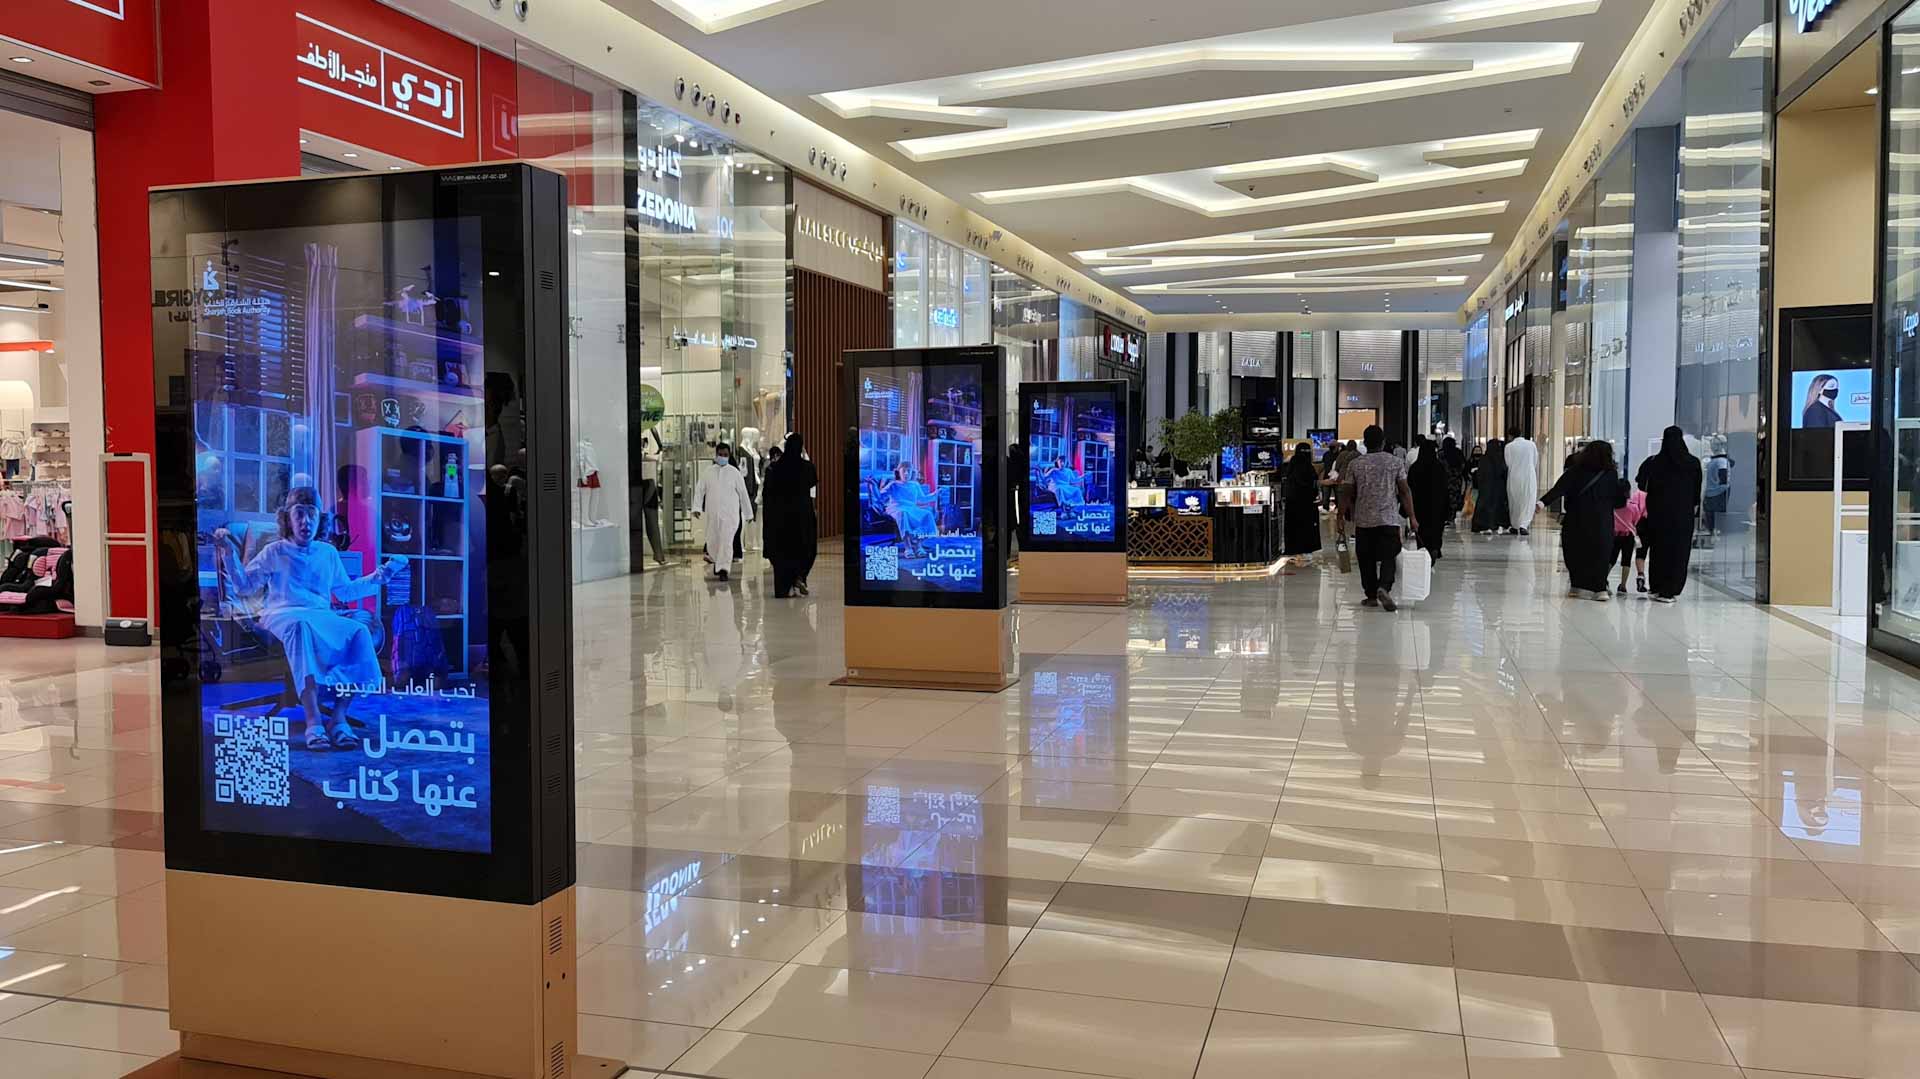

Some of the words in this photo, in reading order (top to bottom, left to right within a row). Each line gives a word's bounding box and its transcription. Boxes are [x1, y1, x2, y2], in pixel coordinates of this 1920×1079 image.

[296, 42, 340, 80] الأطف
[341, 63, 377, 88] متجر
[392, 72, 454, 119] زدي
[637, 187, 696, 231] ZEDONIA
[242, 306, 271, 315] Authority
[1077, 509, 1110, 522] بتحصل
[1065, 522, 1089, 535] كتاب
[1091, 522, 1111, 534] عنها
[929, 543, 976, 562] بتحصل
[911, 563, 945, 580] كتاب
[949, 563, 977, 581] عنها
[391, 673, 435, 699] ألعاب
[439, 683, 476, 702] تحب
[363, 714, 475, 765] بتحصل
[322, 765, 400, 810] كتاب
[412, 769, 478, 816] عنها
